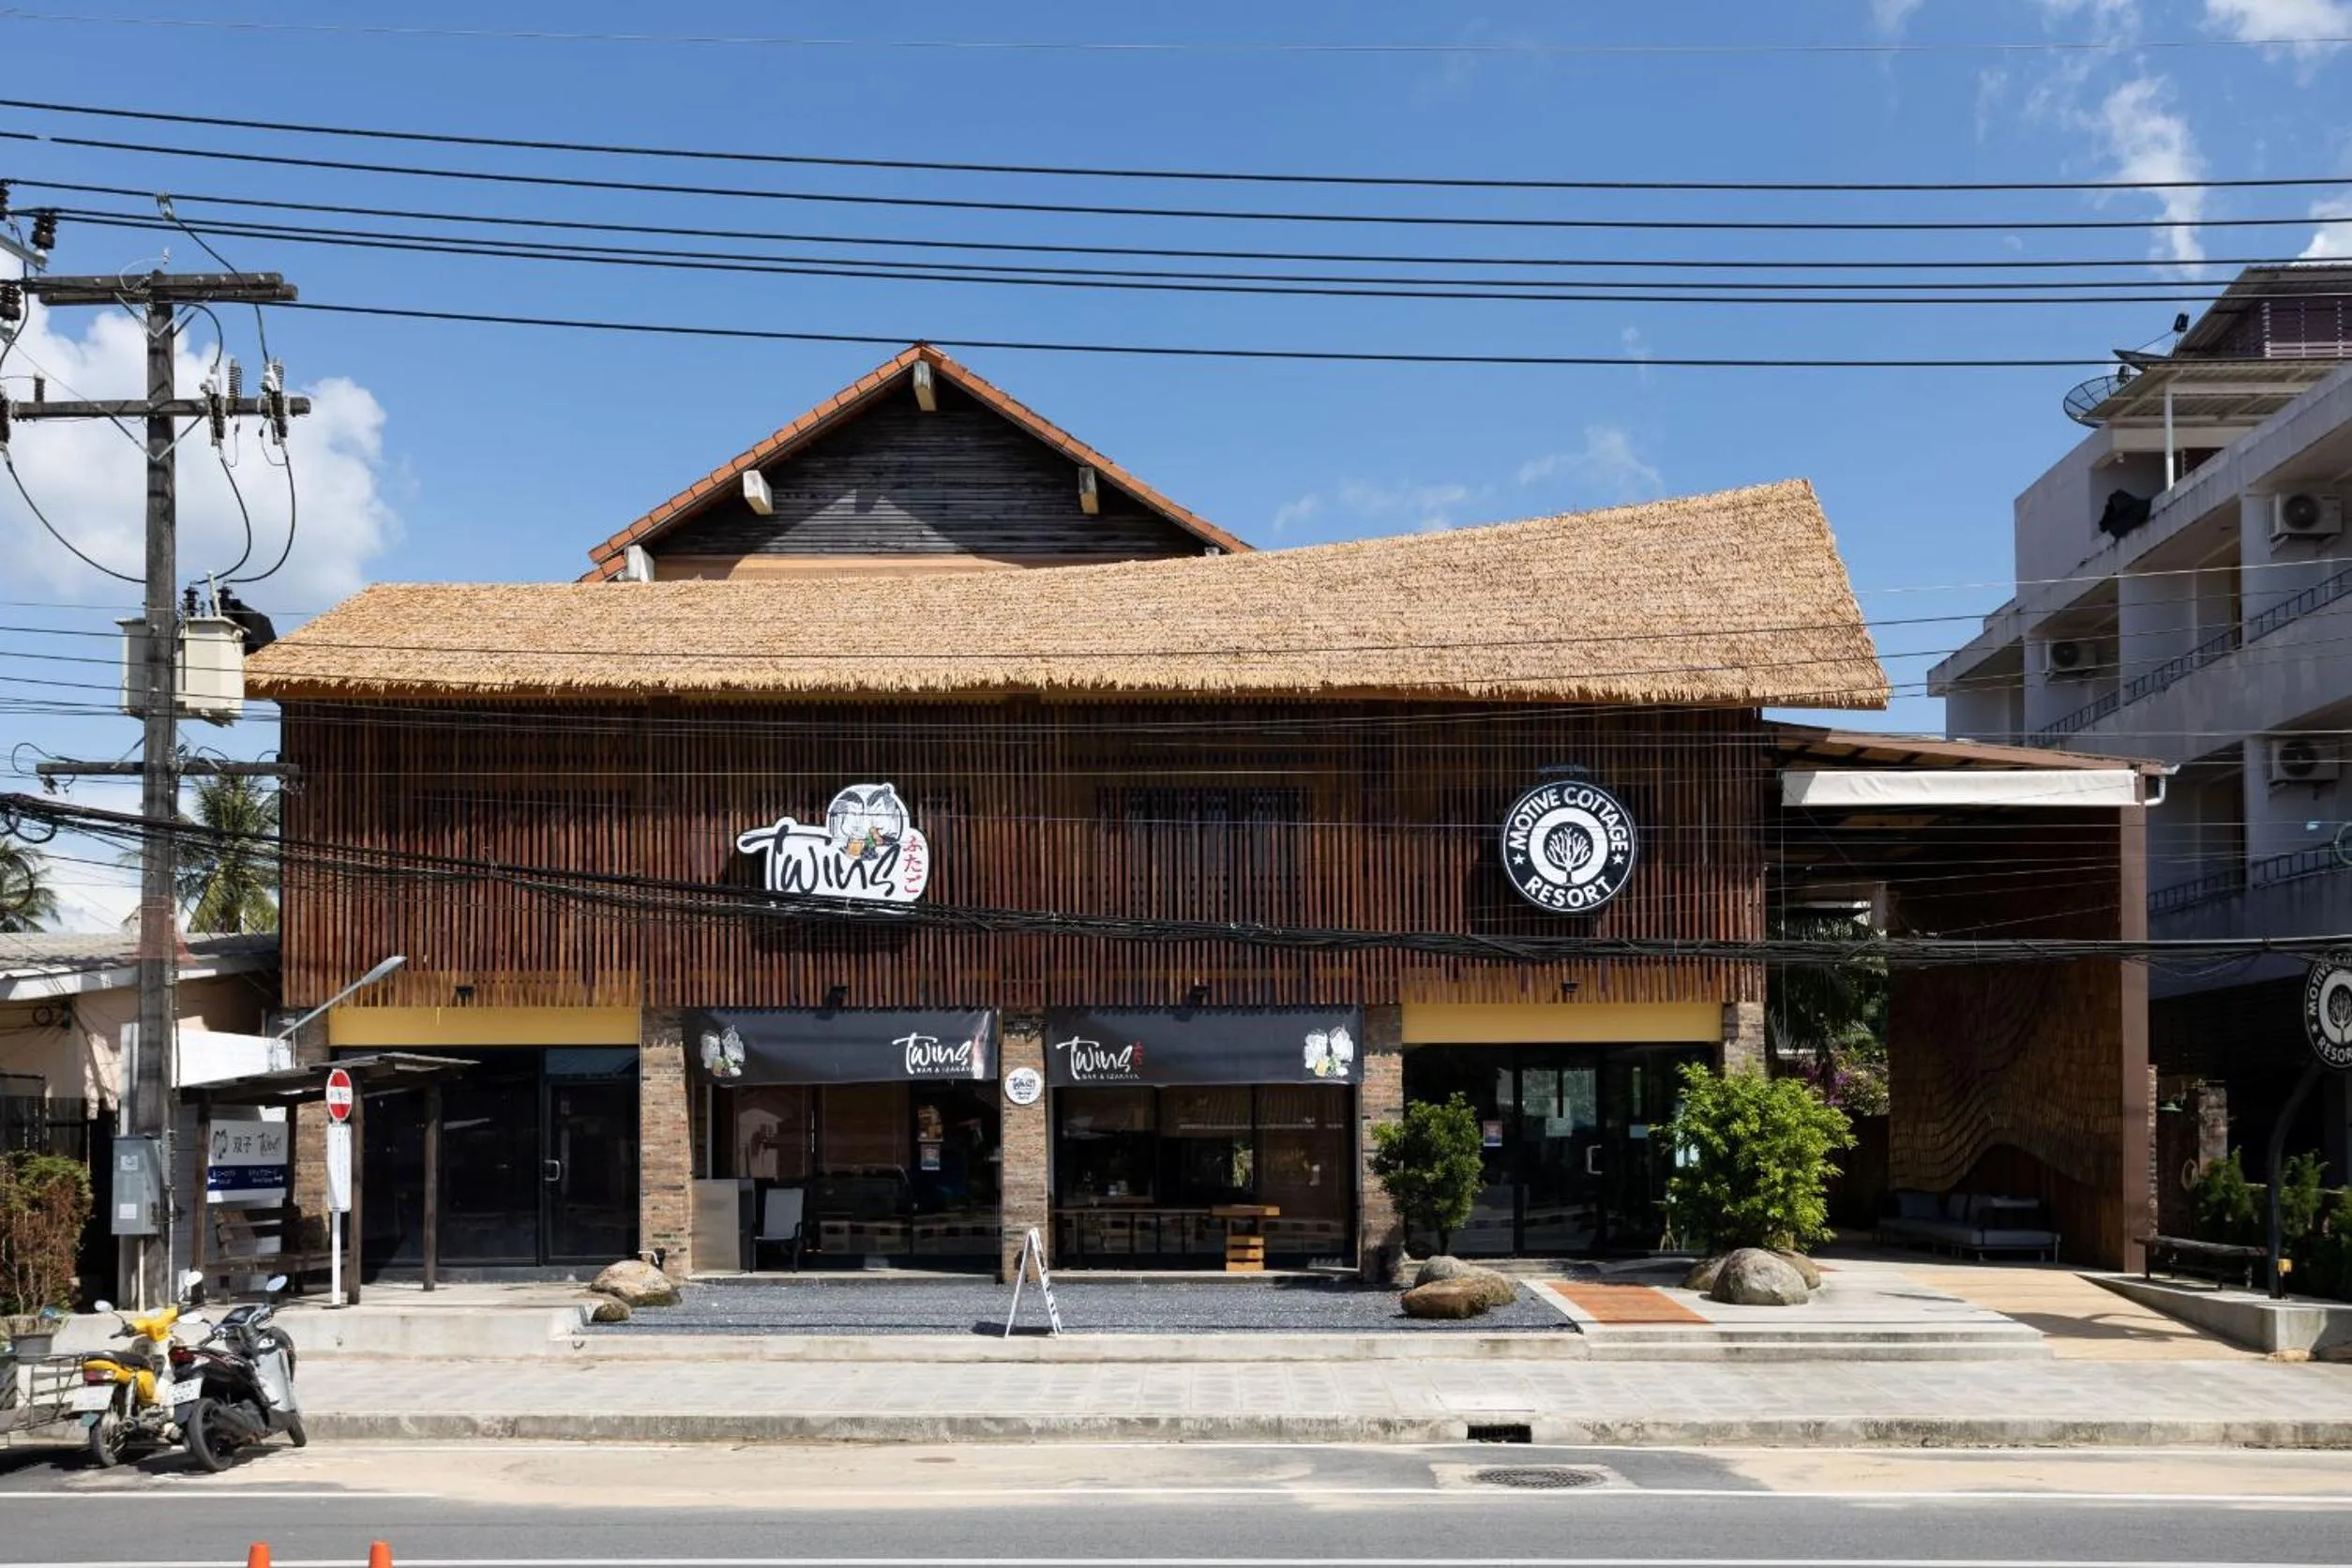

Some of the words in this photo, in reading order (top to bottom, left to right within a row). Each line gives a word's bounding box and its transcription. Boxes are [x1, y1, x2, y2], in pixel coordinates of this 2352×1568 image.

[1508, 788, 1561, 852] MOTIVE
[1562, 786, 1629, 852] COTTAGE
[741, 823, 902, 897] Twins
[902, 835, 924, 894] ふたご
[1524, 875, 1613, 908] RESORT
[892, 1032, 972, 1076] Twins
[1055, 1035, 1133, 1080] Twins
